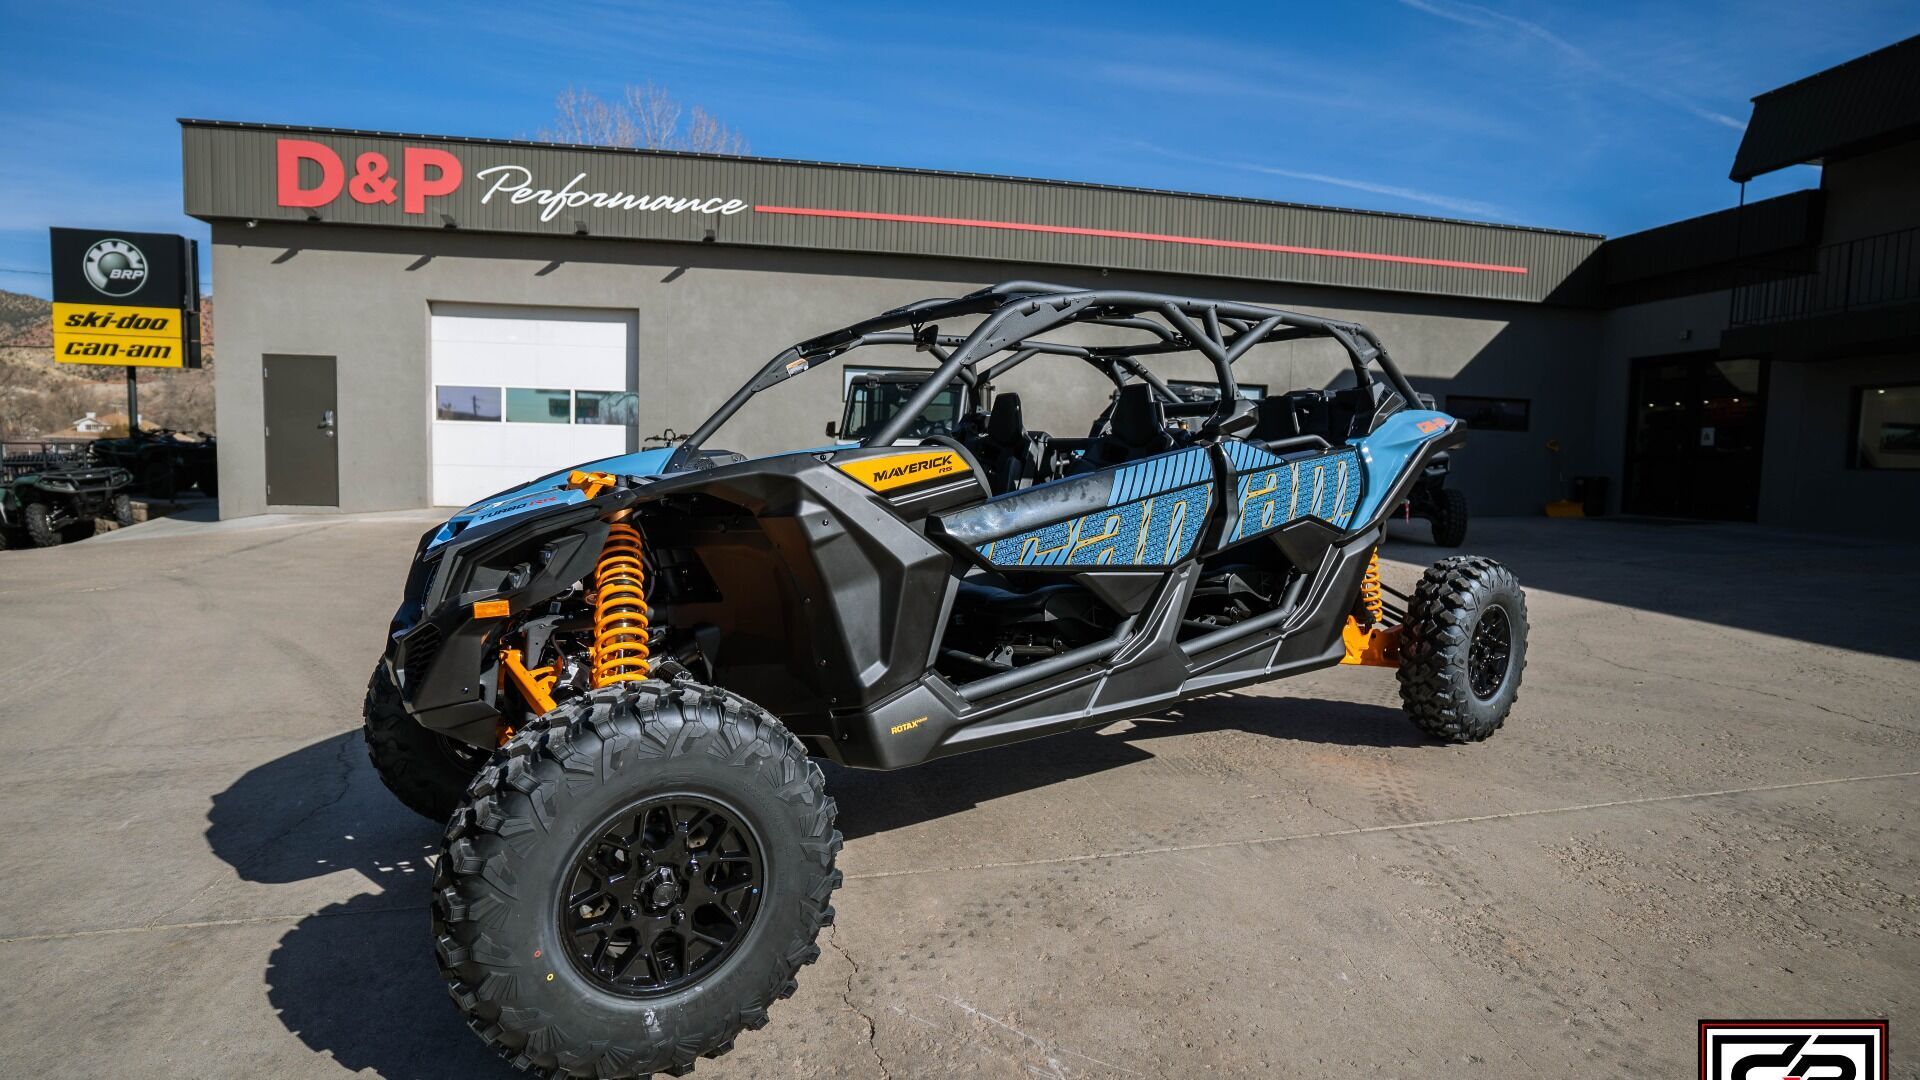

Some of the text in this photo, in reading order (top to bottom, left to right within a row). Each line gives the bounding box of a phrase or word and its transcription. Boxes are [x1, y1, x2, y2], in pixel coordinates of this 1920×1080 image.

[276, 138, 749, 222] D&P Performance
[109, 269, 144, 280] BRP
[64, 311, 169, 331] ski-doo
[64, 341, 172, 359] can-am
[873, 454, 953, 482] MAVERICK
[891, 720, 918, 735] ROTAX
